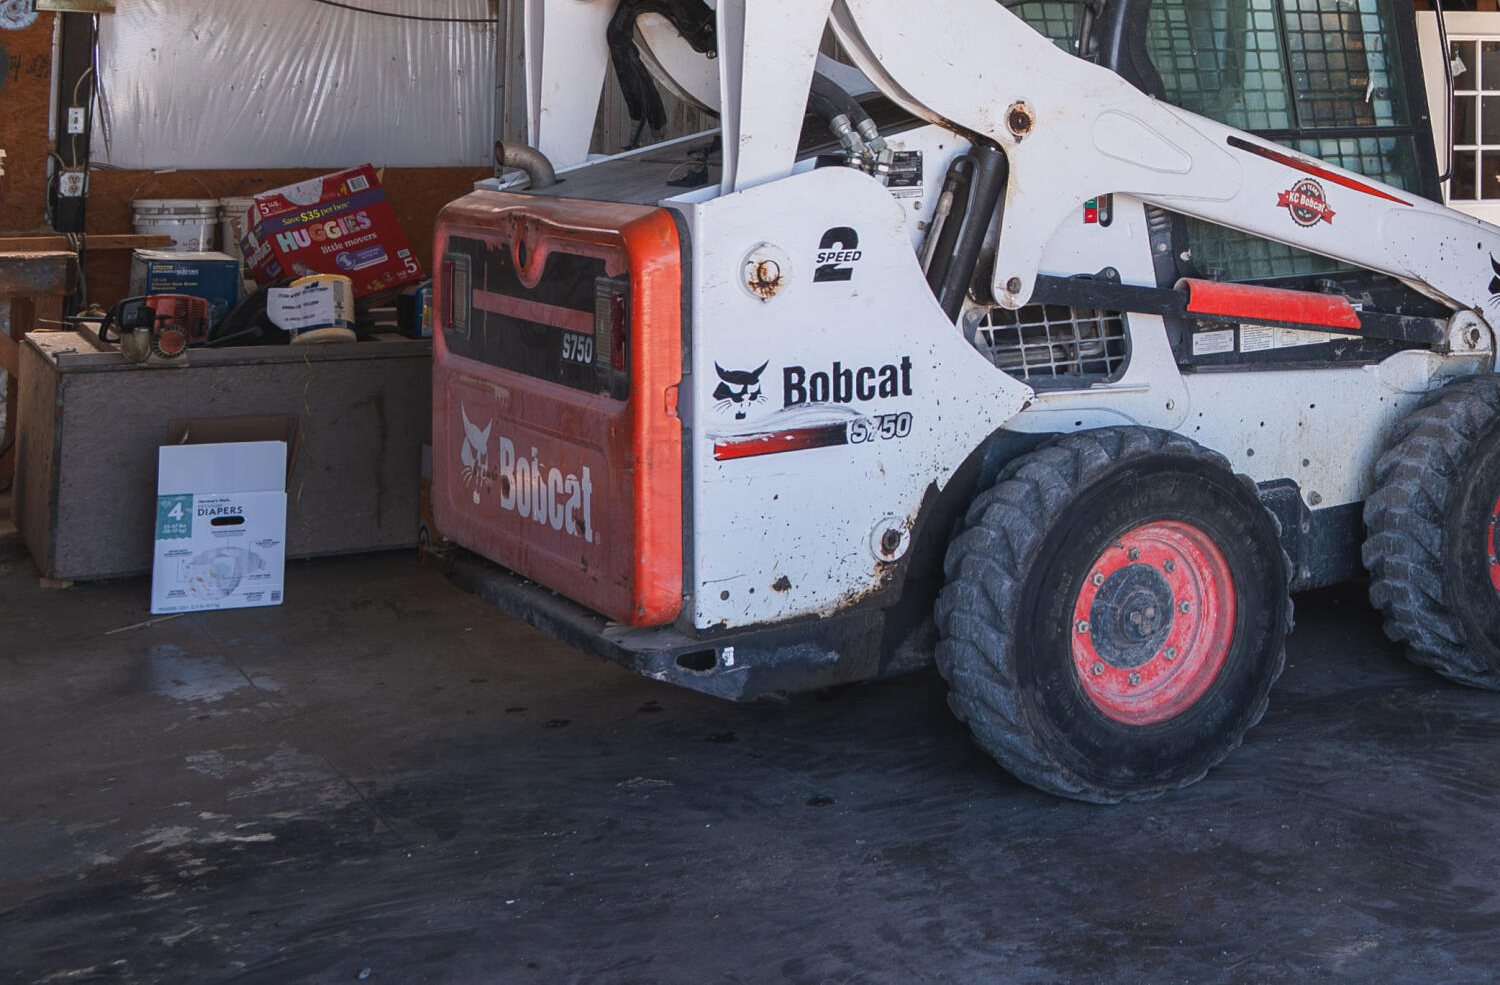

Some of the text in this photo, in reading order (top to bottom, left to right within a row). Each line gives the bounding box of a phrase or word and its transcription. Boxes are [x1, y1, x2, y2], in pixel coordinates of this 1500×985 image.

[260, 202, 270, 215] 5
[1289, 192, 1300, 203] KC
[1300, 194, 1325, 214] Bobcat
[281, 215, 301, 226] Save
[300, 210, 321, 223] $35
[321, 206, 333, 216] per
[275, 211, 372, 254] HUGGIES
[320, 240, 344, 255] little
[344, 232, 378, 248] movers
[813, 226, 859, 283] 2
[816, 250, 862, 264] SPEED
[404, 258, 418, 275] 5
[562, 333, 593, 364] S750
[783, 355, 913, 409] Bobcat
[850, 412, 914, 444] S750
[499, 436, 593, 543] Bobcat
[167, 502, 184, 521] 4
[197, 505, 243, 517] DIAPERS
